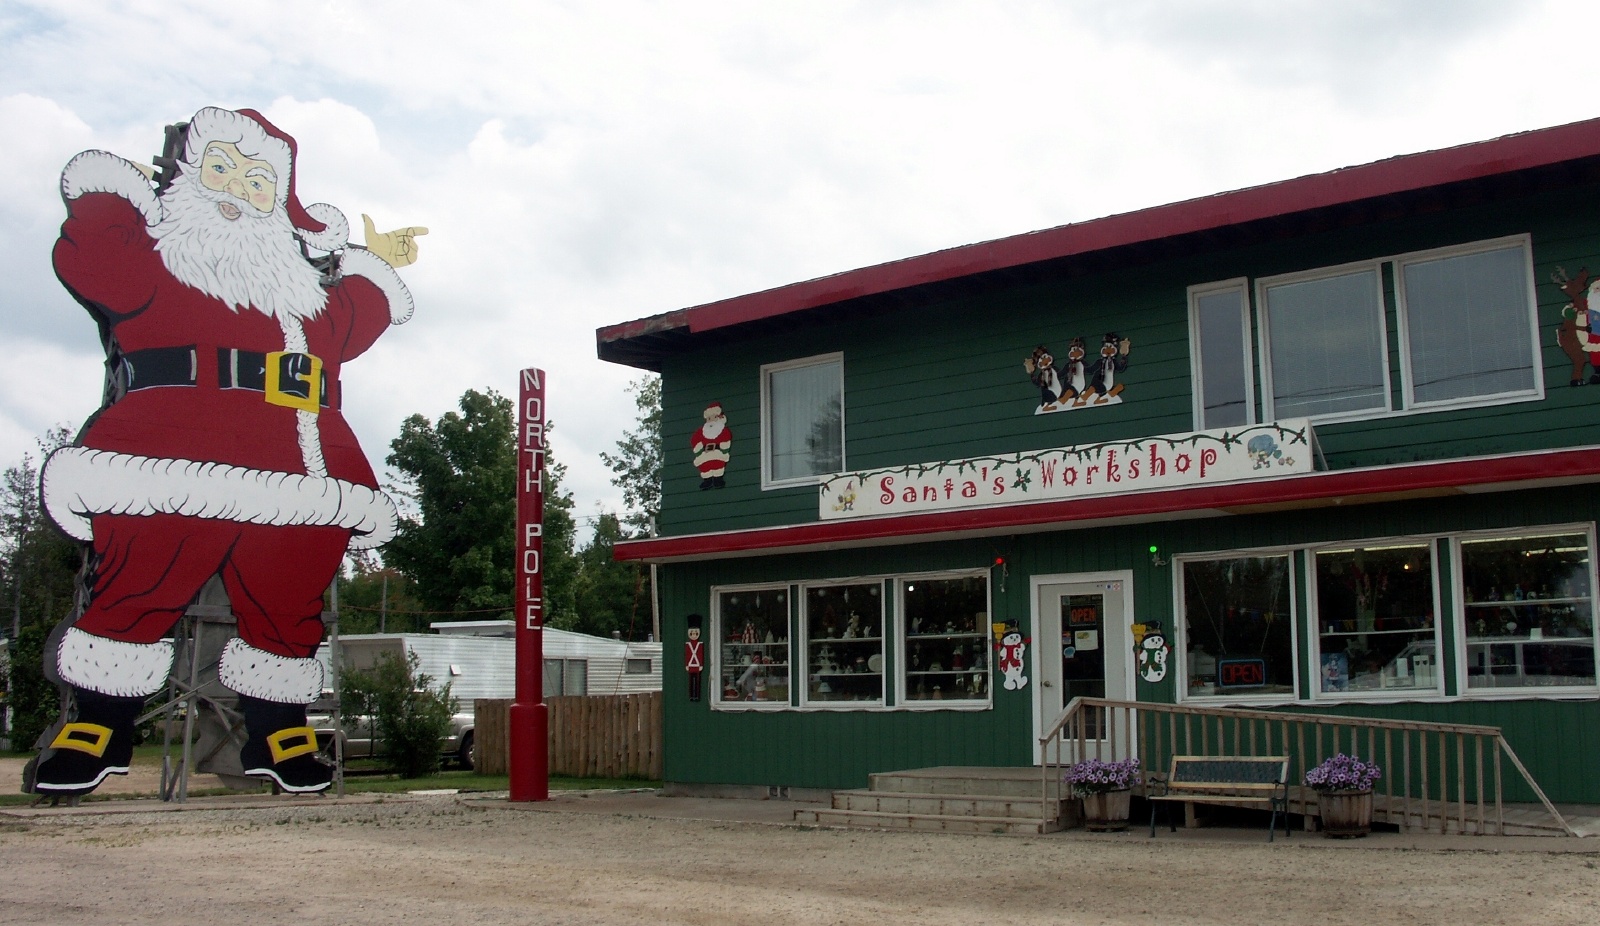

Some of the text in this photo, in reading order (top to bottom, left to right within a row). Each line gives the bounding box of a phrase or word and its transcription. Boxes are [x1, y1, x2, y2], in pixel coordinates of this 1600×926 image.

[880, 443, 1217, 505] Santa's Workshop
[523, 368, 544, 630] NORTH POLE
[1071, 608, 1096, 623] OPEN
[1222, 664, 1263, 683] OPEN
